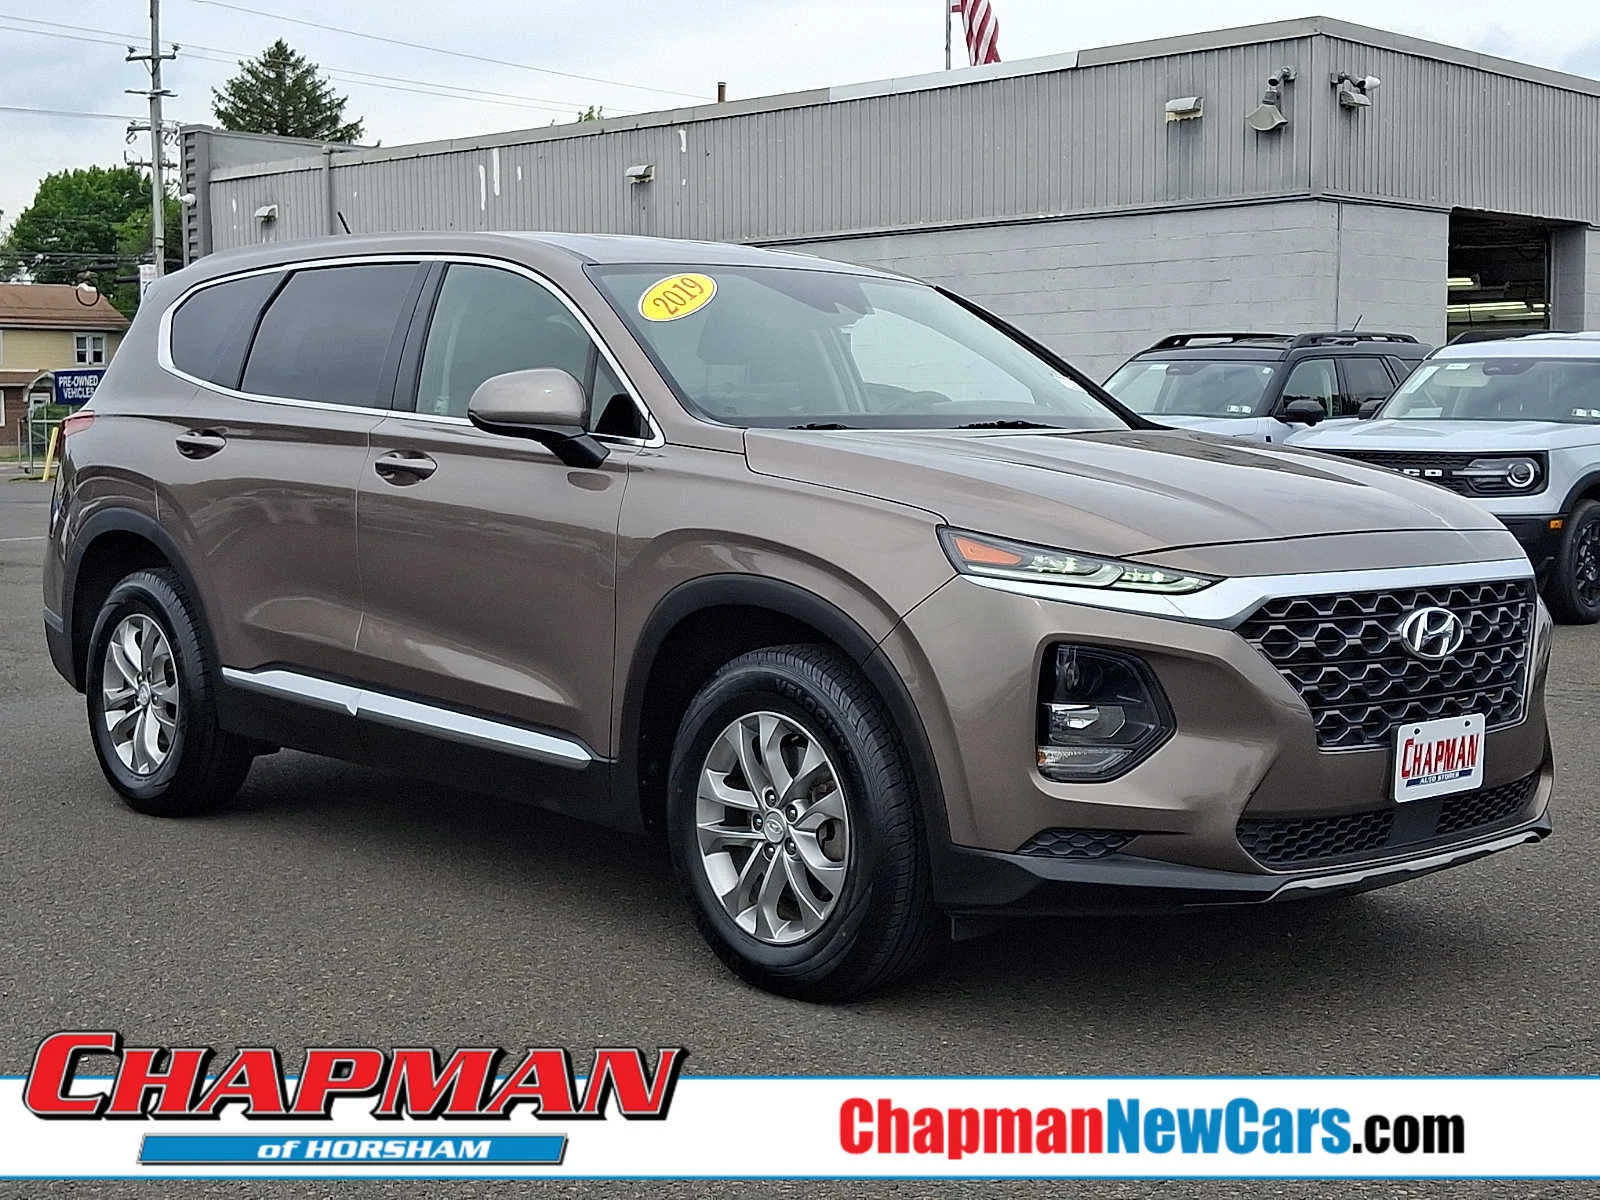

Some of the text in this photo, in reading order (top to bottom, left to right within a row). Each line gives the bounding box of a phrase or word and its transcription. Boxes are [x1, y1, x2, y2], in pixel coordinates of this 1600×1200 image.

[654, 277, 704, 315] 2019
[58, 375, 99, 387] PRE-OWNED
[63, 387, 95, 399] VEHICLES
[1401, 733, 1480, 779] CHAPMAN
